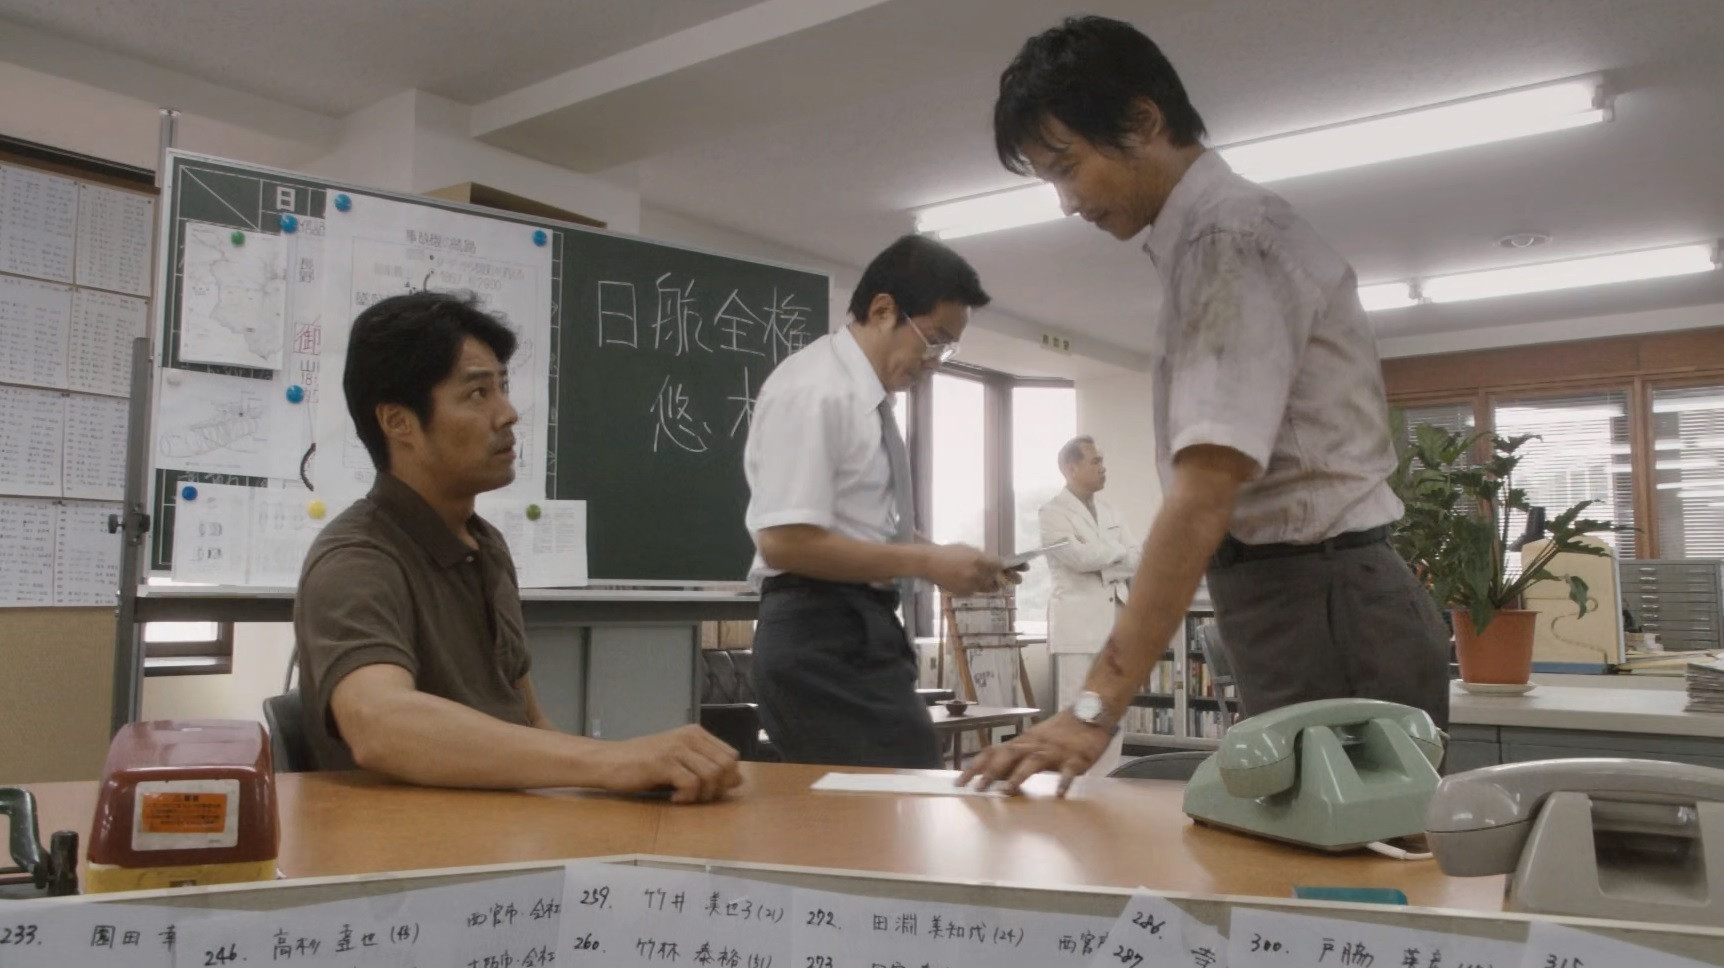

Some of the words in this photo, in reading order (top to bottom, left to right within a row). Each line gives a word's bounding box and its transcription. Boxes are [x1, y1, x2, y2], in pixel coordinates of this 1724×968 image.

[598, 271, 811, 365] 日航全権
[580, 886, 612, 909] 259.
[645, 888, 685, 913] 竹井
[806, 909, 841, 930] 272.
[0, 925, 42, 945] 233.
[574, 932, 606, 953] 260.
[1250, 933, 1290, 954] 300.
[204, 943, 247, 967] 246.
